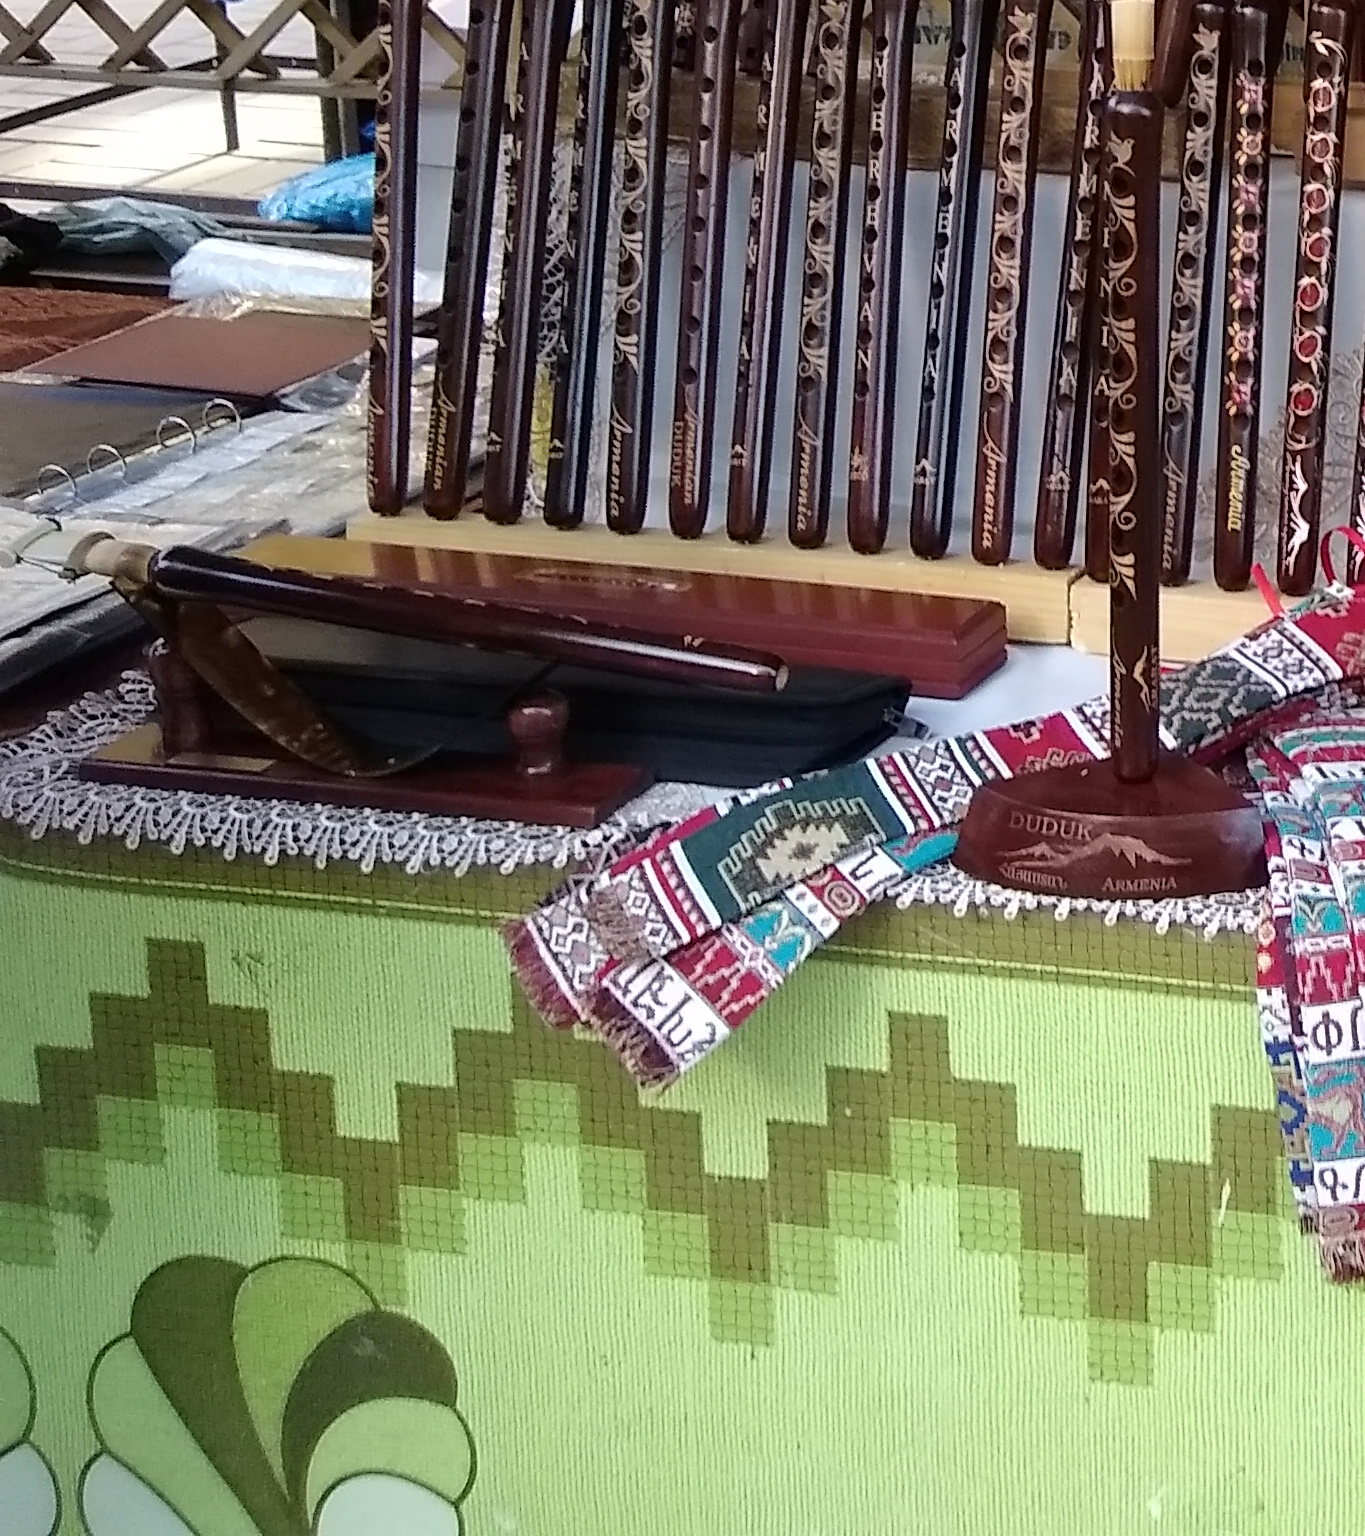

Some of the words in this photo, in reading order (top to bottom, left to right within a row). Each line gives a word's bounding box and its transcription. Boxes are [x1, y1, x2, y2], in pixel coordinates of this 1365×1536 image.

[923, 66, 963, 378] ARMENIA
[1060, 68, 1106, 386] ARMENIA
[432, 372, 456, 491] Armenian
[608, 402, 634, 518] Armenia
[671, 420, 683, 488] DUDUK
[683, 383, 702, 505] Armenian
[796, 396, 820, 532] Armenia
[980, 409, 1006, 549] Armenia
[1227, 443, 1250, 532] Armenia
[1162, 431, 1184, 569] Armenia
[1112, 626, 1127, 748] Armenia
[1009, 811, 1094, 841] DUDUK
[1102, 876, 1178, 893] ARMENIA
